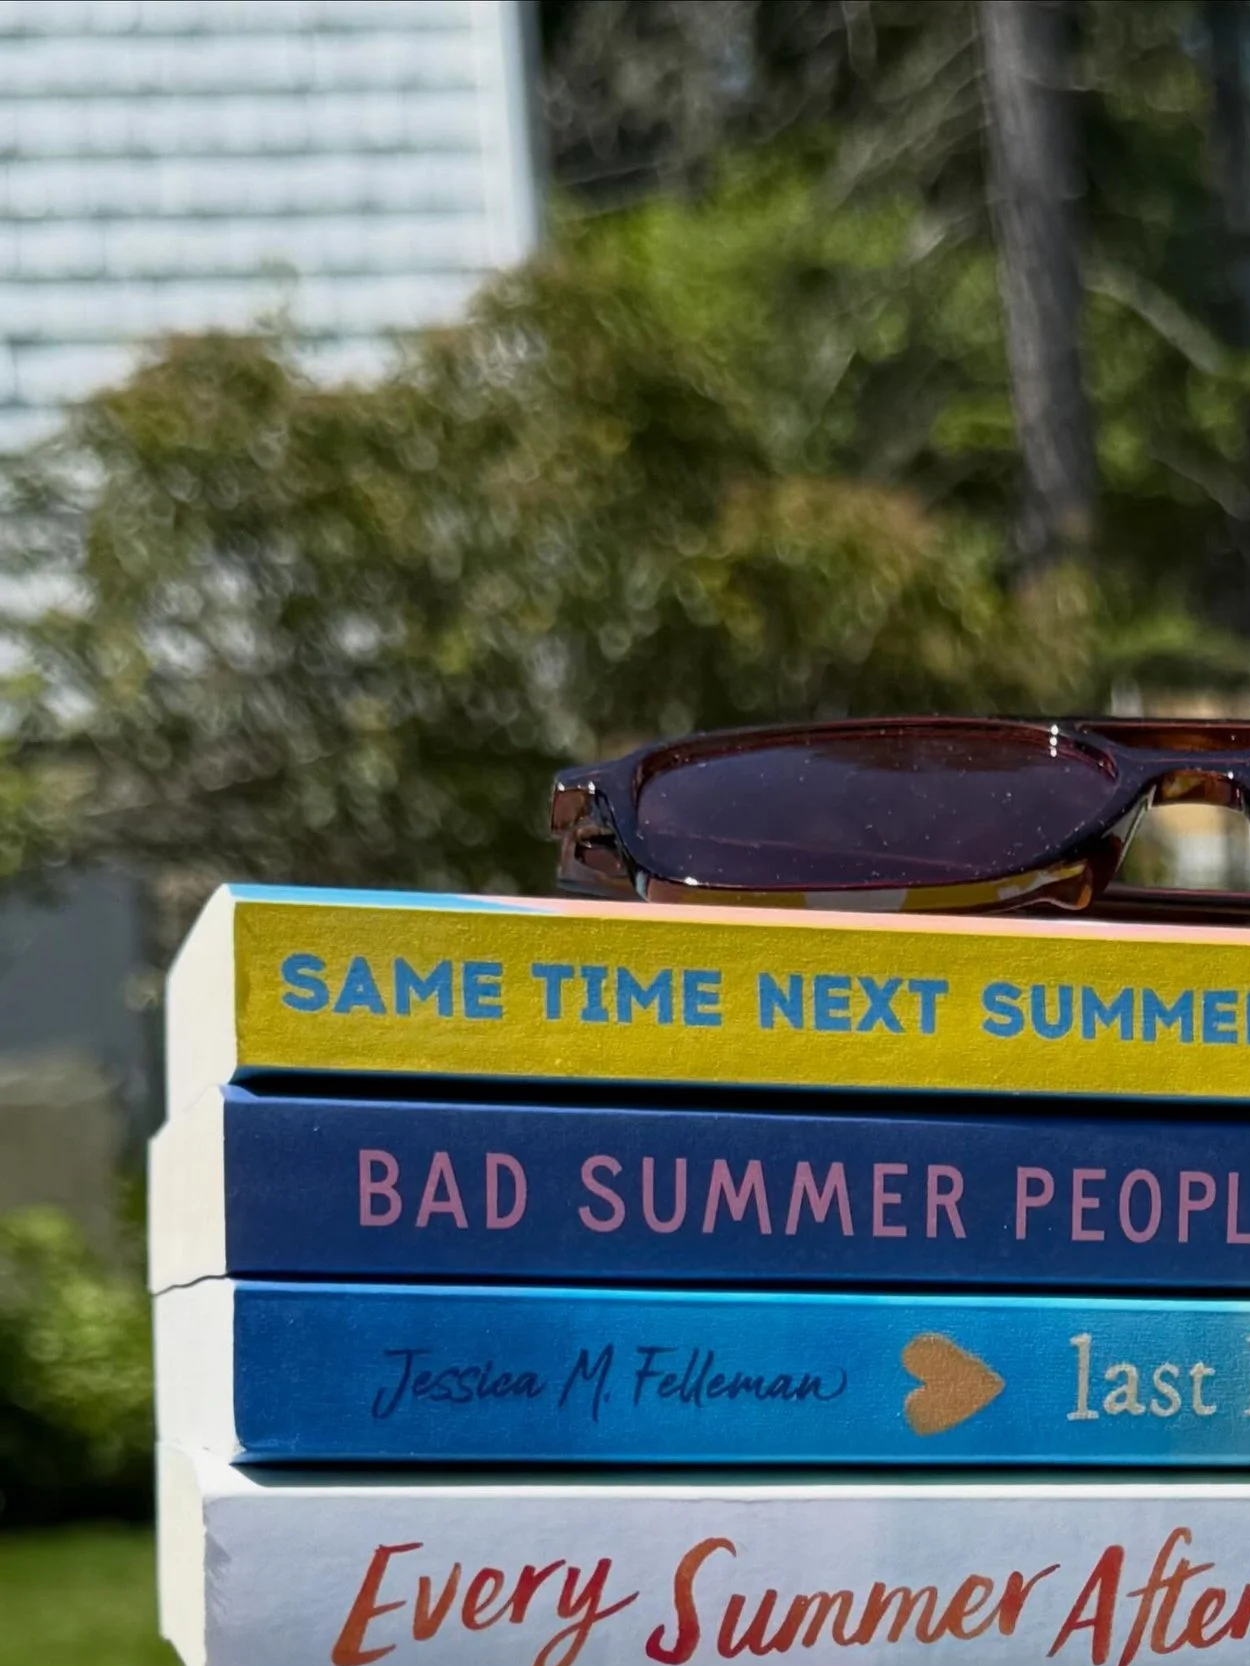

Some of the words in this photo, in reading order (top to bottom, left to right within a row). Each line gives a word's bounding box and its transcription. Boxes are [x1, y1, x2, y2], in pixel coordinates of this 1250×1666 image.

[280, 954, 503, 1018] SAME
[531, 963, 722, 1027] TIME
[759, 972, 948, 1034] NEXT
[358, 1149, 527, 1230] BAD
[578, 1154, 966, 1239] SUMMER
[371, 1346, 545, 1420] Jessica
[557, 1342, 612, 1421] M.
[636, 1344, 848, 1410] Felleman
[1067, 1332, 1216, 1421] last
[645, 1536, 1059, 1665] Summer
